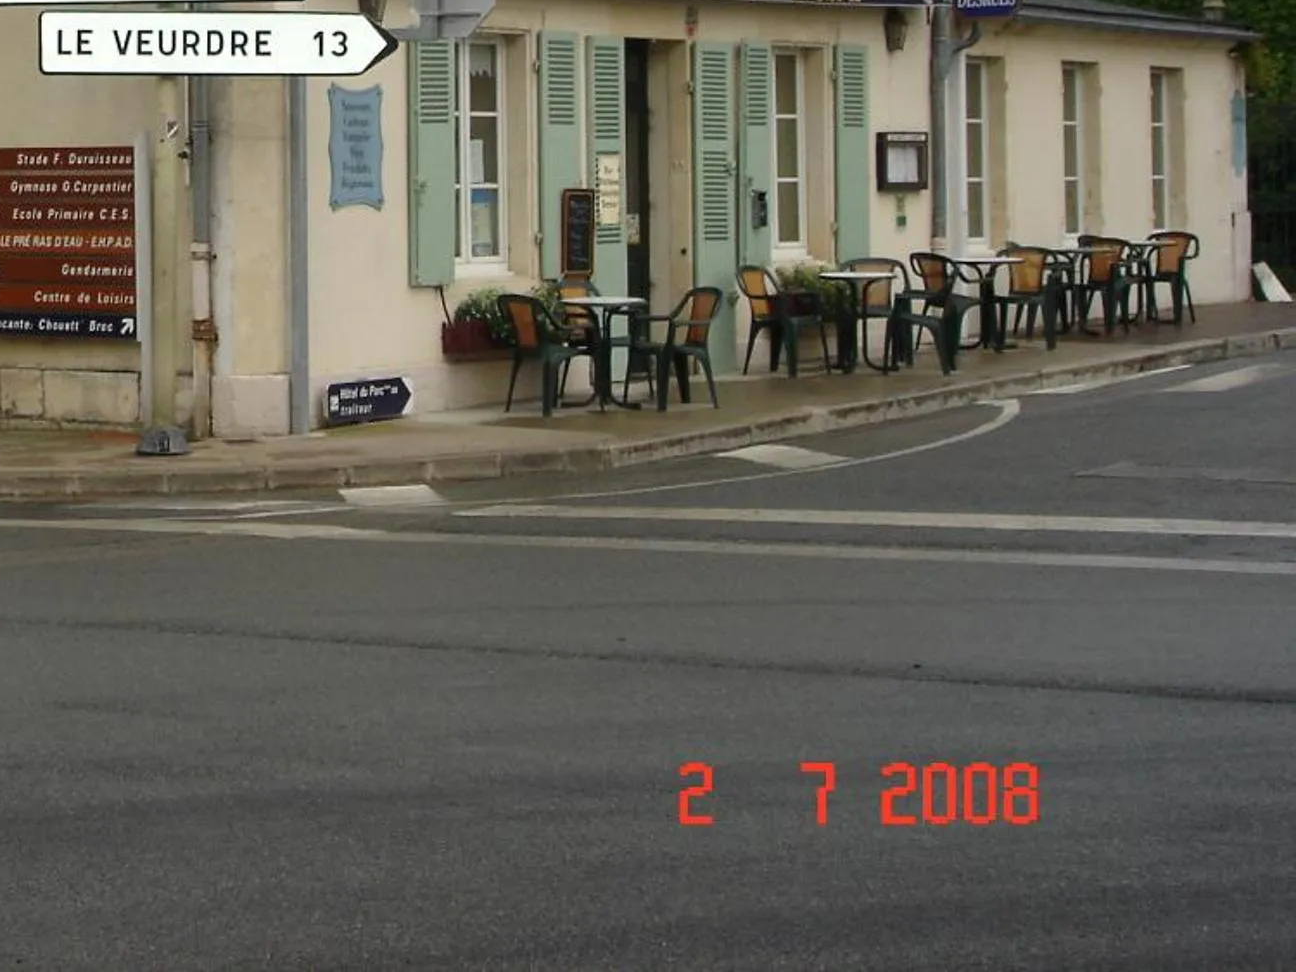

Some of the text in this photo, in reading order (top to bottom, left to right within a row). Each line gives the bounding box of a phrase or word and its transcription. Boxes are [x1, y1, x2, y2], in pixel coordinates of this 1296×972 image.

[57, 29, 349, 57] LE VEURDRE 13
[17, 153, 48, 165] Stade
[10, 180, 57, 195] Gymnase
[47, 207, 94, 220] Primaire
[0, 235, 10, 247] LE
[61, 263, 133, 277] Gendarmerie
[34, 290, 134, 305] Centre de Loisirs
[89, 319, 113, 332] Broc
